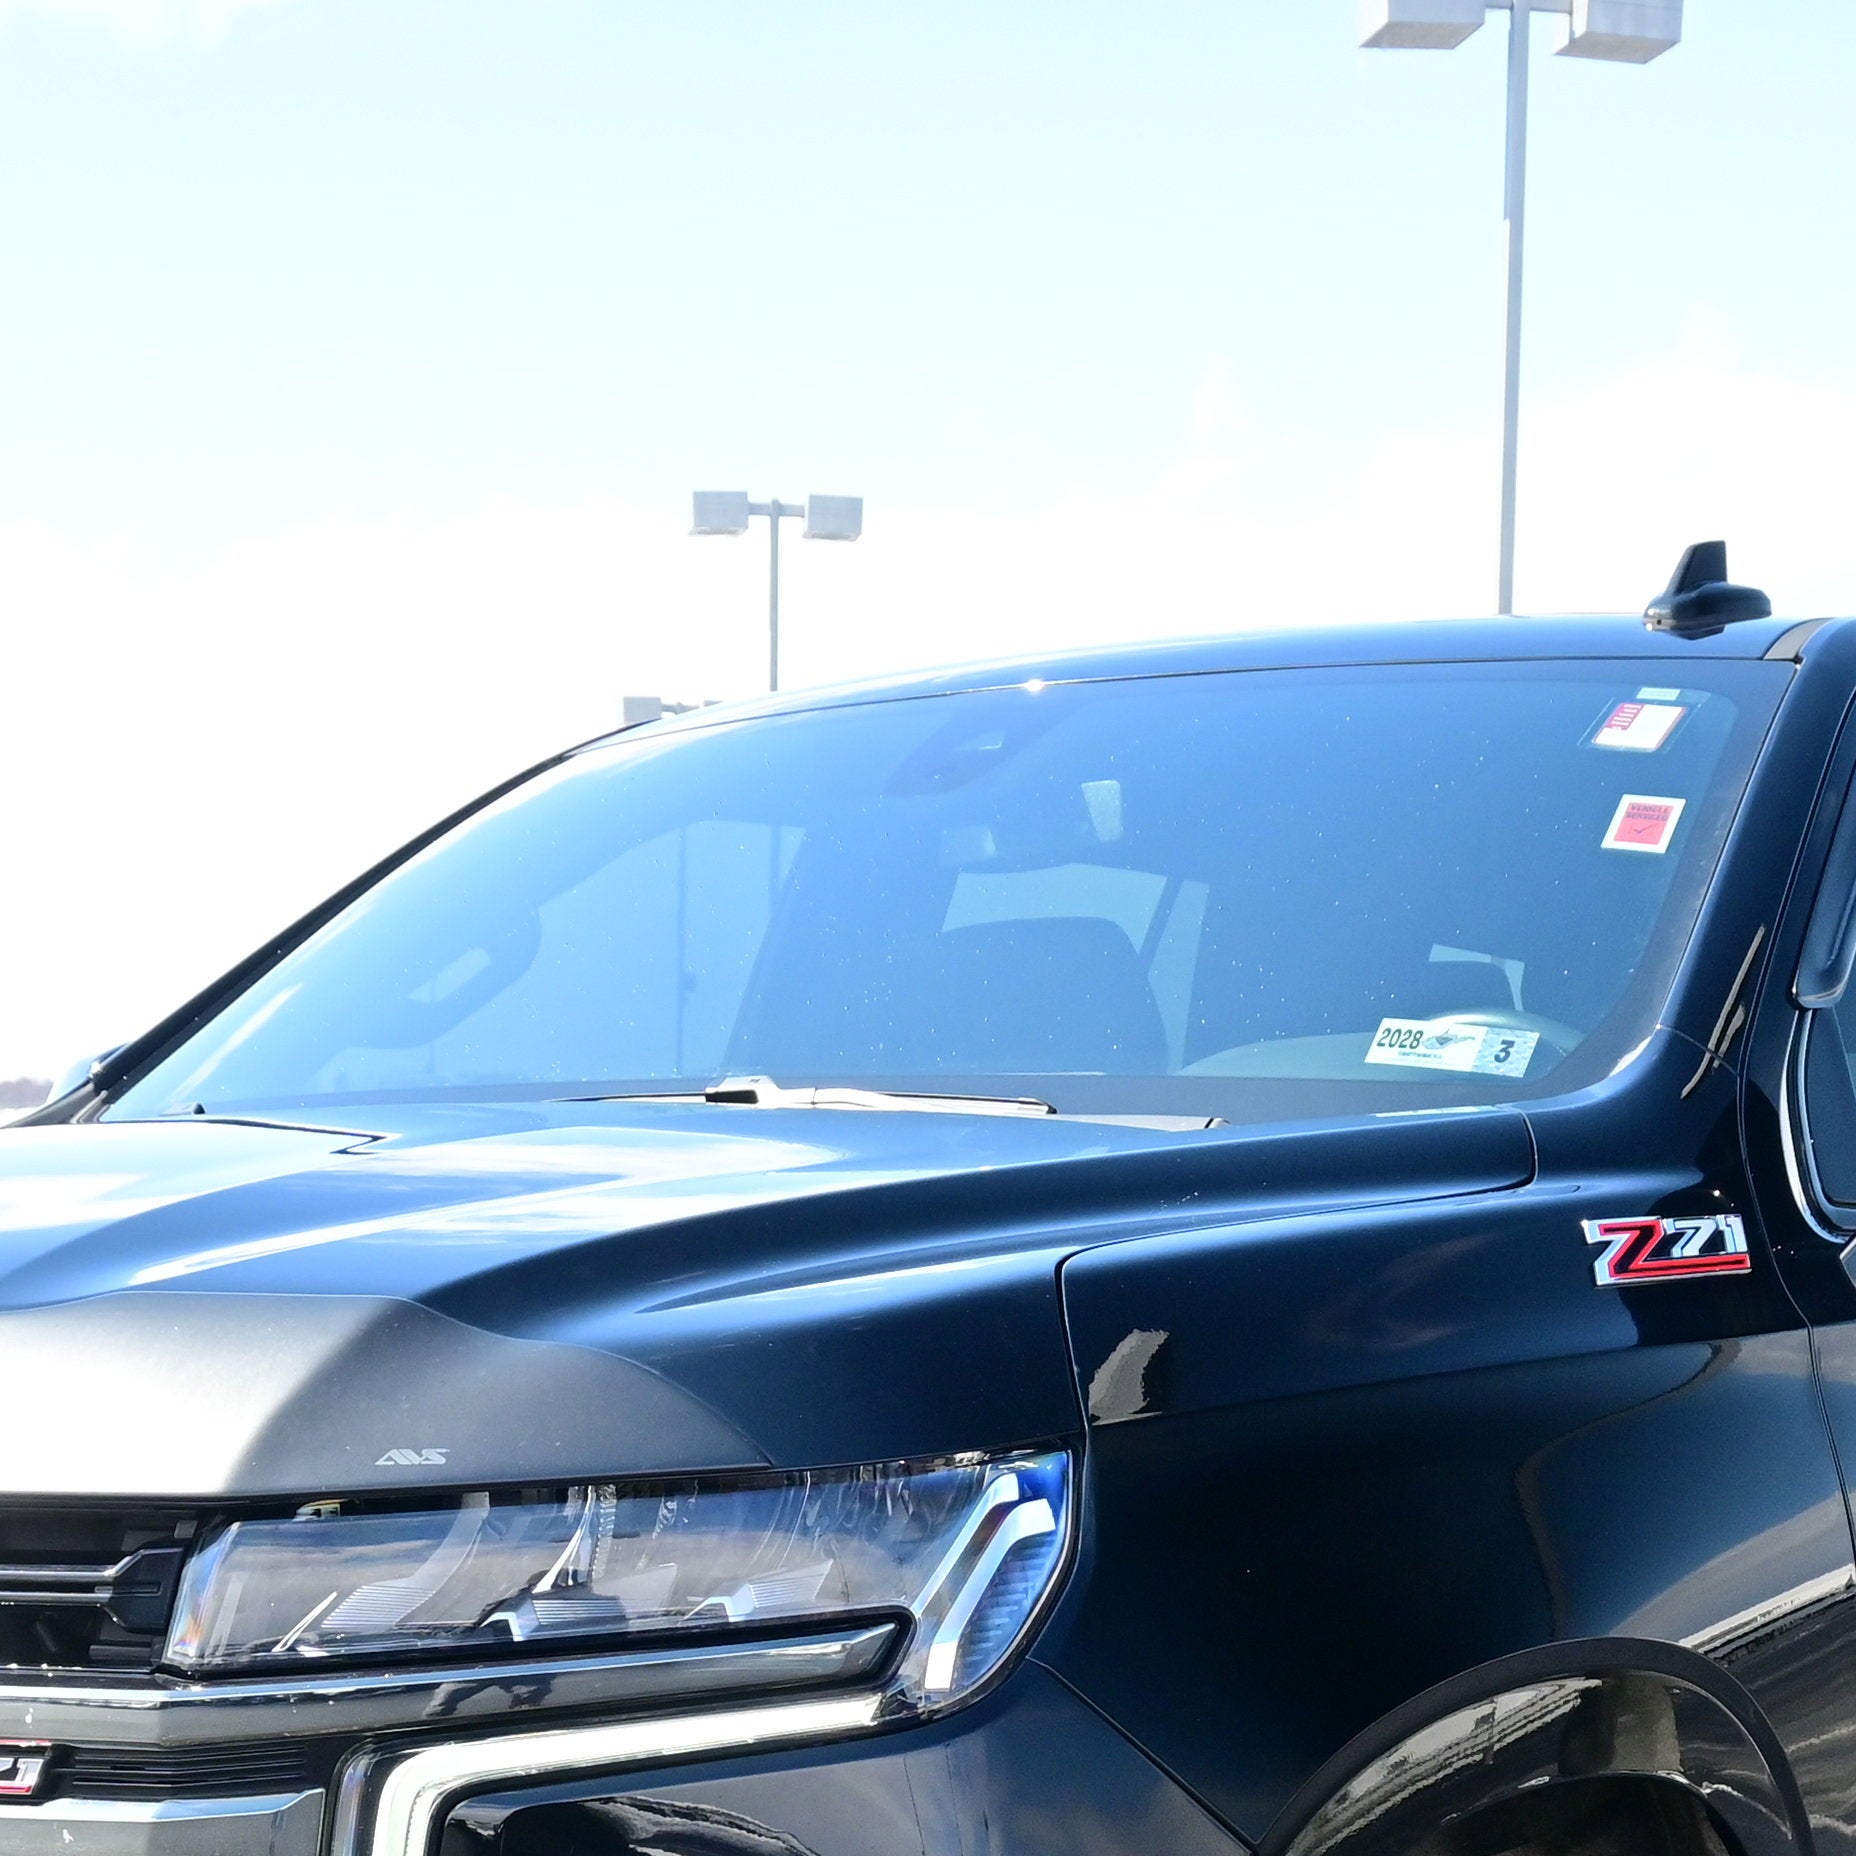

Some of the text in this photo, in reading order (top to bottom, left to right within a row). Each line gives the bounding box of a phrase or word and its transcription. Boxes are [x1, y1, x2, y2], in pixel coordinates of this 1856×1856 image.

[1376, 1027, 1516, 1063] 2028 3
[1580, 1213, 1753, 1287] Z71
[373, 1448, 451, 1466] AVS
